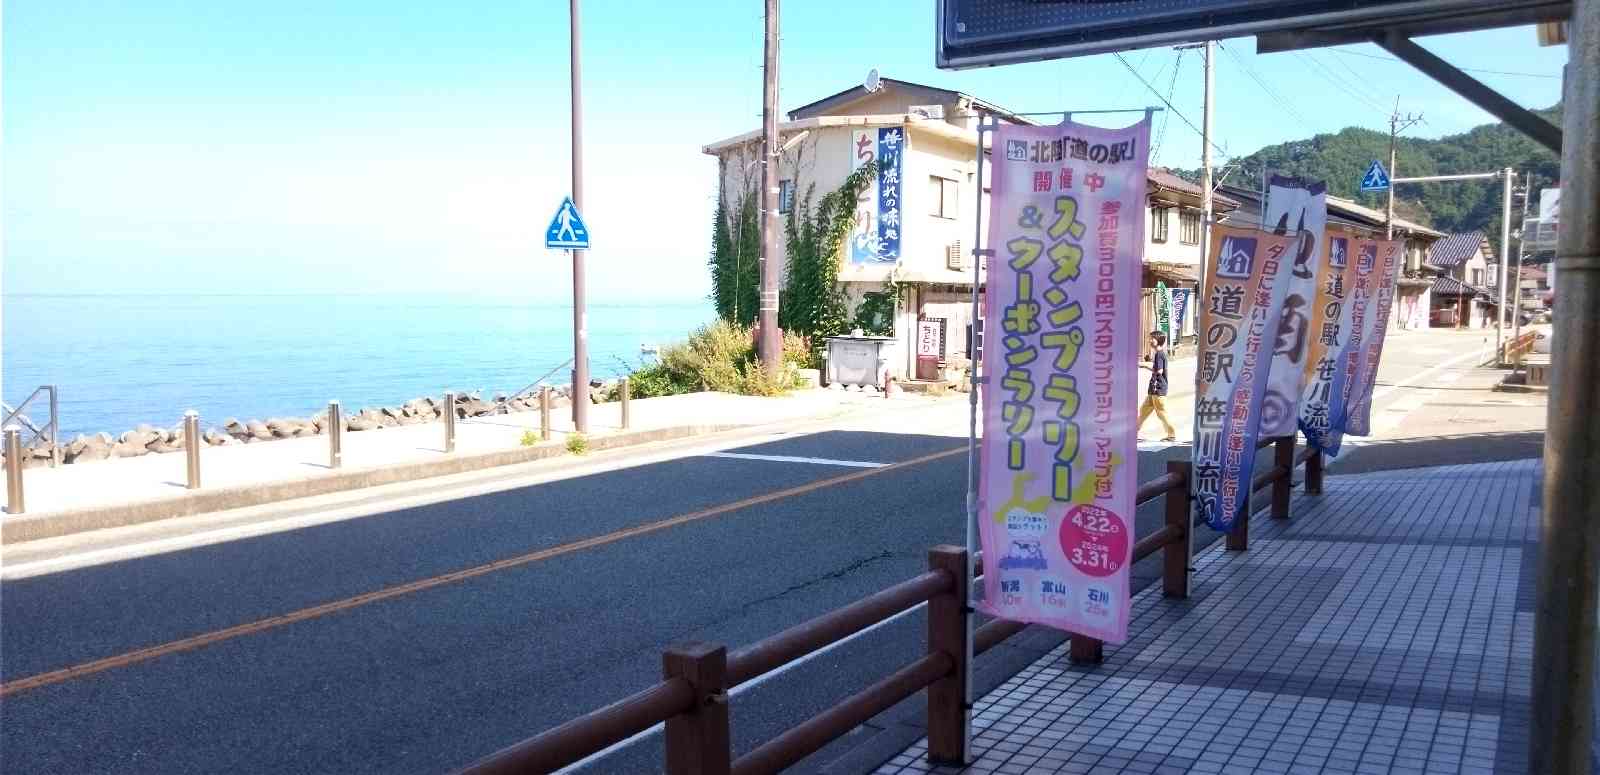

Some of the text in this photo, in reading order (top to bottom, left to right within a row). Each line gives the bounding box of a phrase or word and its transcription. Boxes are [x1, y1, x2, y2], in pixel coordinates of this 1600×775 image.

[880, 129, 903, 241] 笹川流れの味処
[1040, 195, 1087, 503] スタンプラリー
[1202, 285, 1246, 384] 道の駅
[1320, 273, 1346, 347] 道の駅
[1040, 580, 1066, 595] 富山
[1087, 588, 1109, 602] 石川
